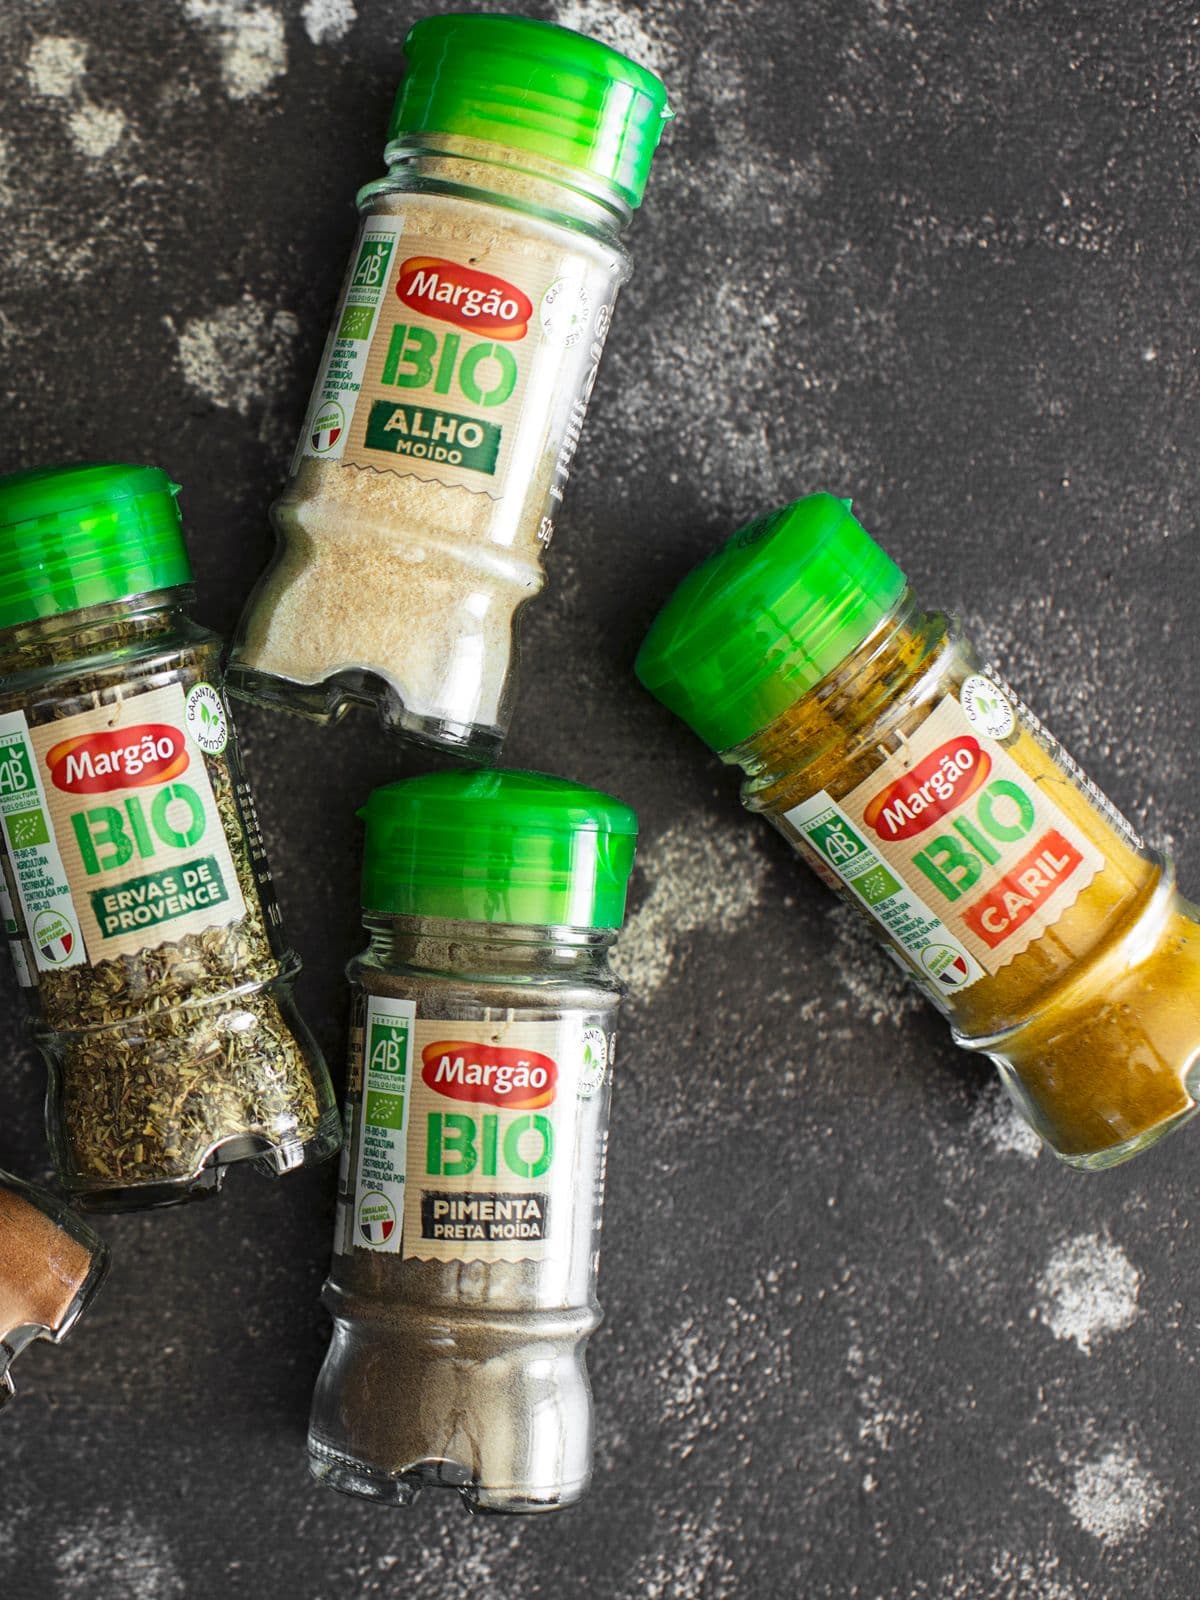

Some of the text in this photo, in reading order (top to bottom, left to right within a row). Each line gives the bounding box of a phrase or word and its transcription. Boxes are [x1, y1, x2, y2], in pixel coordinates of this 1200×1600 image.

[354, 254, 381, 284] AB
[406, 271, 519, 321] Margão
[380, 323, 518, 407] BIO
[383, 408, 484, 449] ALHO
[396, 438, 462, 465] MOÍDO
[187, 687, 216, 720] GARANTIA
[0, 759, 28, 794] AB
[66, 735, 174, 784] Margão
[881, 747, 974, 835] Margão
[70, 783, 207, 876] BIO
[826, 832, 858, 864] AB
[912, 779, 1035, 903] BIO
[104, 864, 212, 912] ERVAS DE
[104, 882, 221, 934] PROVENCE
[980, 849, 1071, 933] CARIL
[371, 1040, 400, 1071] AB
[434, 1056, 548, 1093] Margão
[426, 1111, 556, 1178] BIO
[433, 1199, 542, 1220] PIMENTA
[434, 1219, 541, 1239] PRETA MOÍDA
